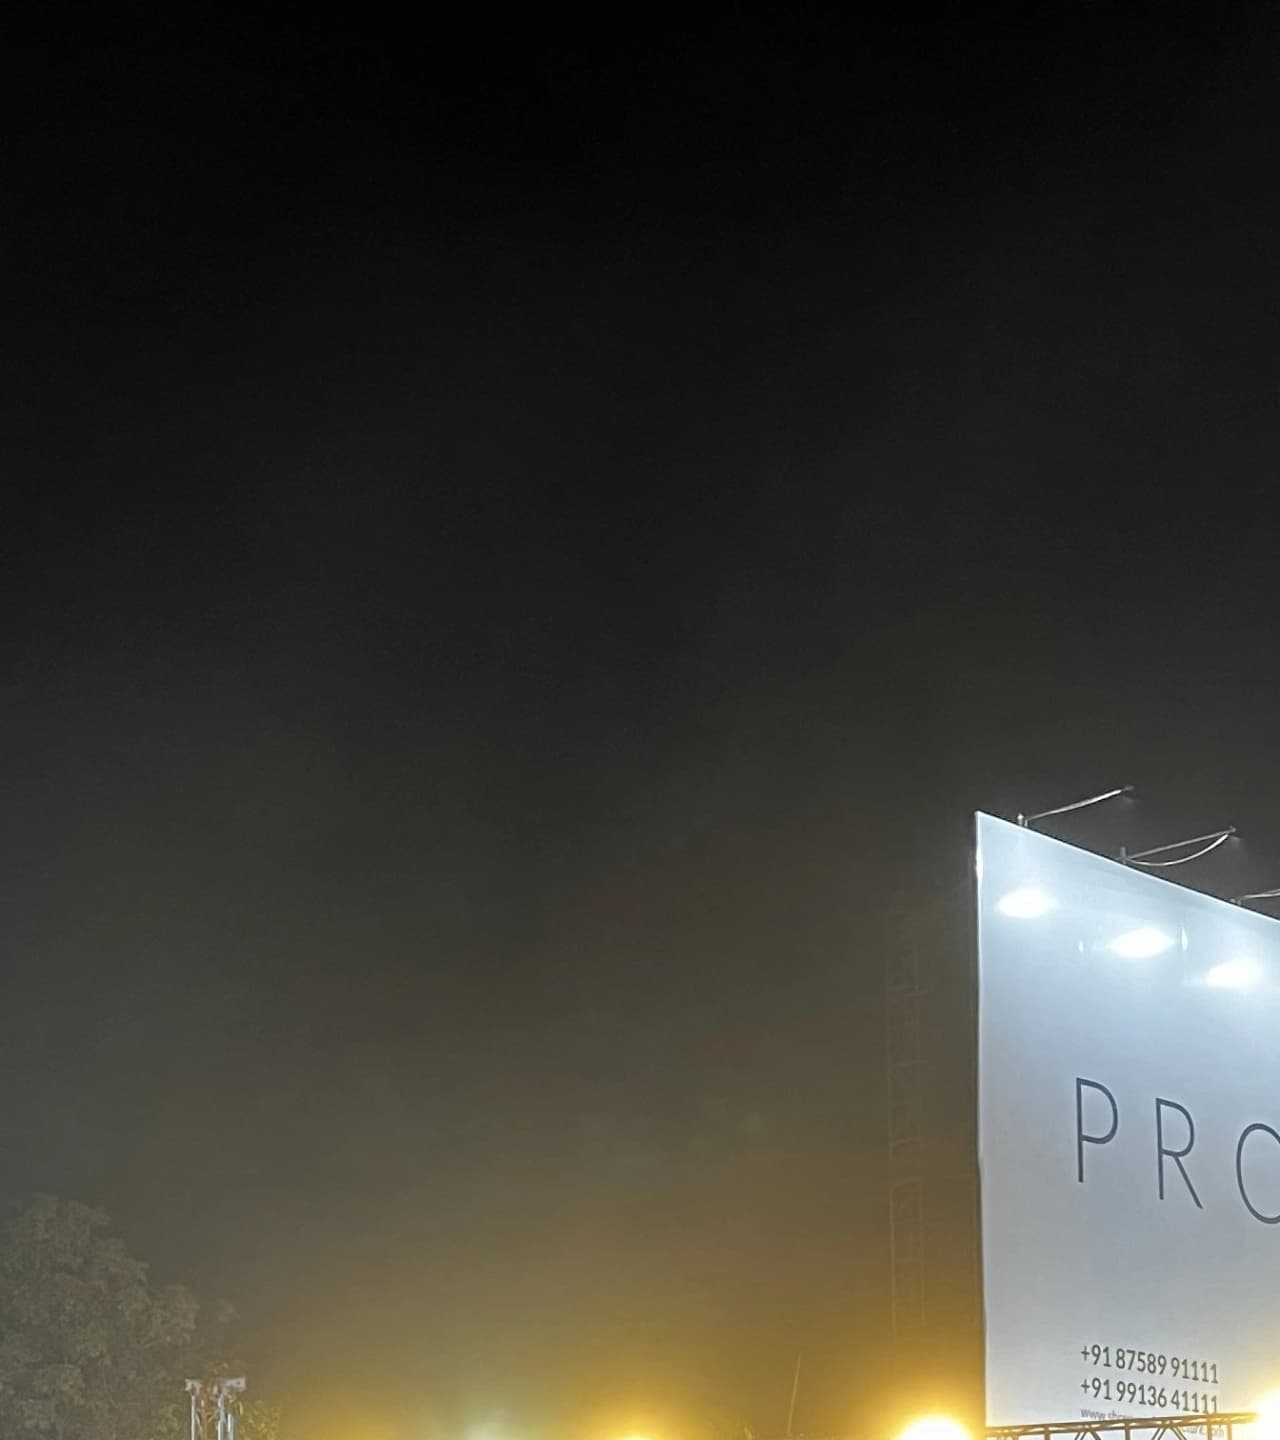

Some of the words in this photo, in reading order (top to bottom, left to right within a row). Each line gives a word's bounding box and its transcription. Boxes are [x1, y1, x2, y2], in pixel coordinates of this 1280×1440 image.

[1080, 1344, 1112, 1368] +91
[1115, 1348, 1167, 1376] 87589
[1171, 1356, 1219, 1384] 91111
[1080, 1377, 1112, 1401] +91
[1116, 1380, 1168, 1408] 99136
[1170, 1389, 1218, 1415] 41111
